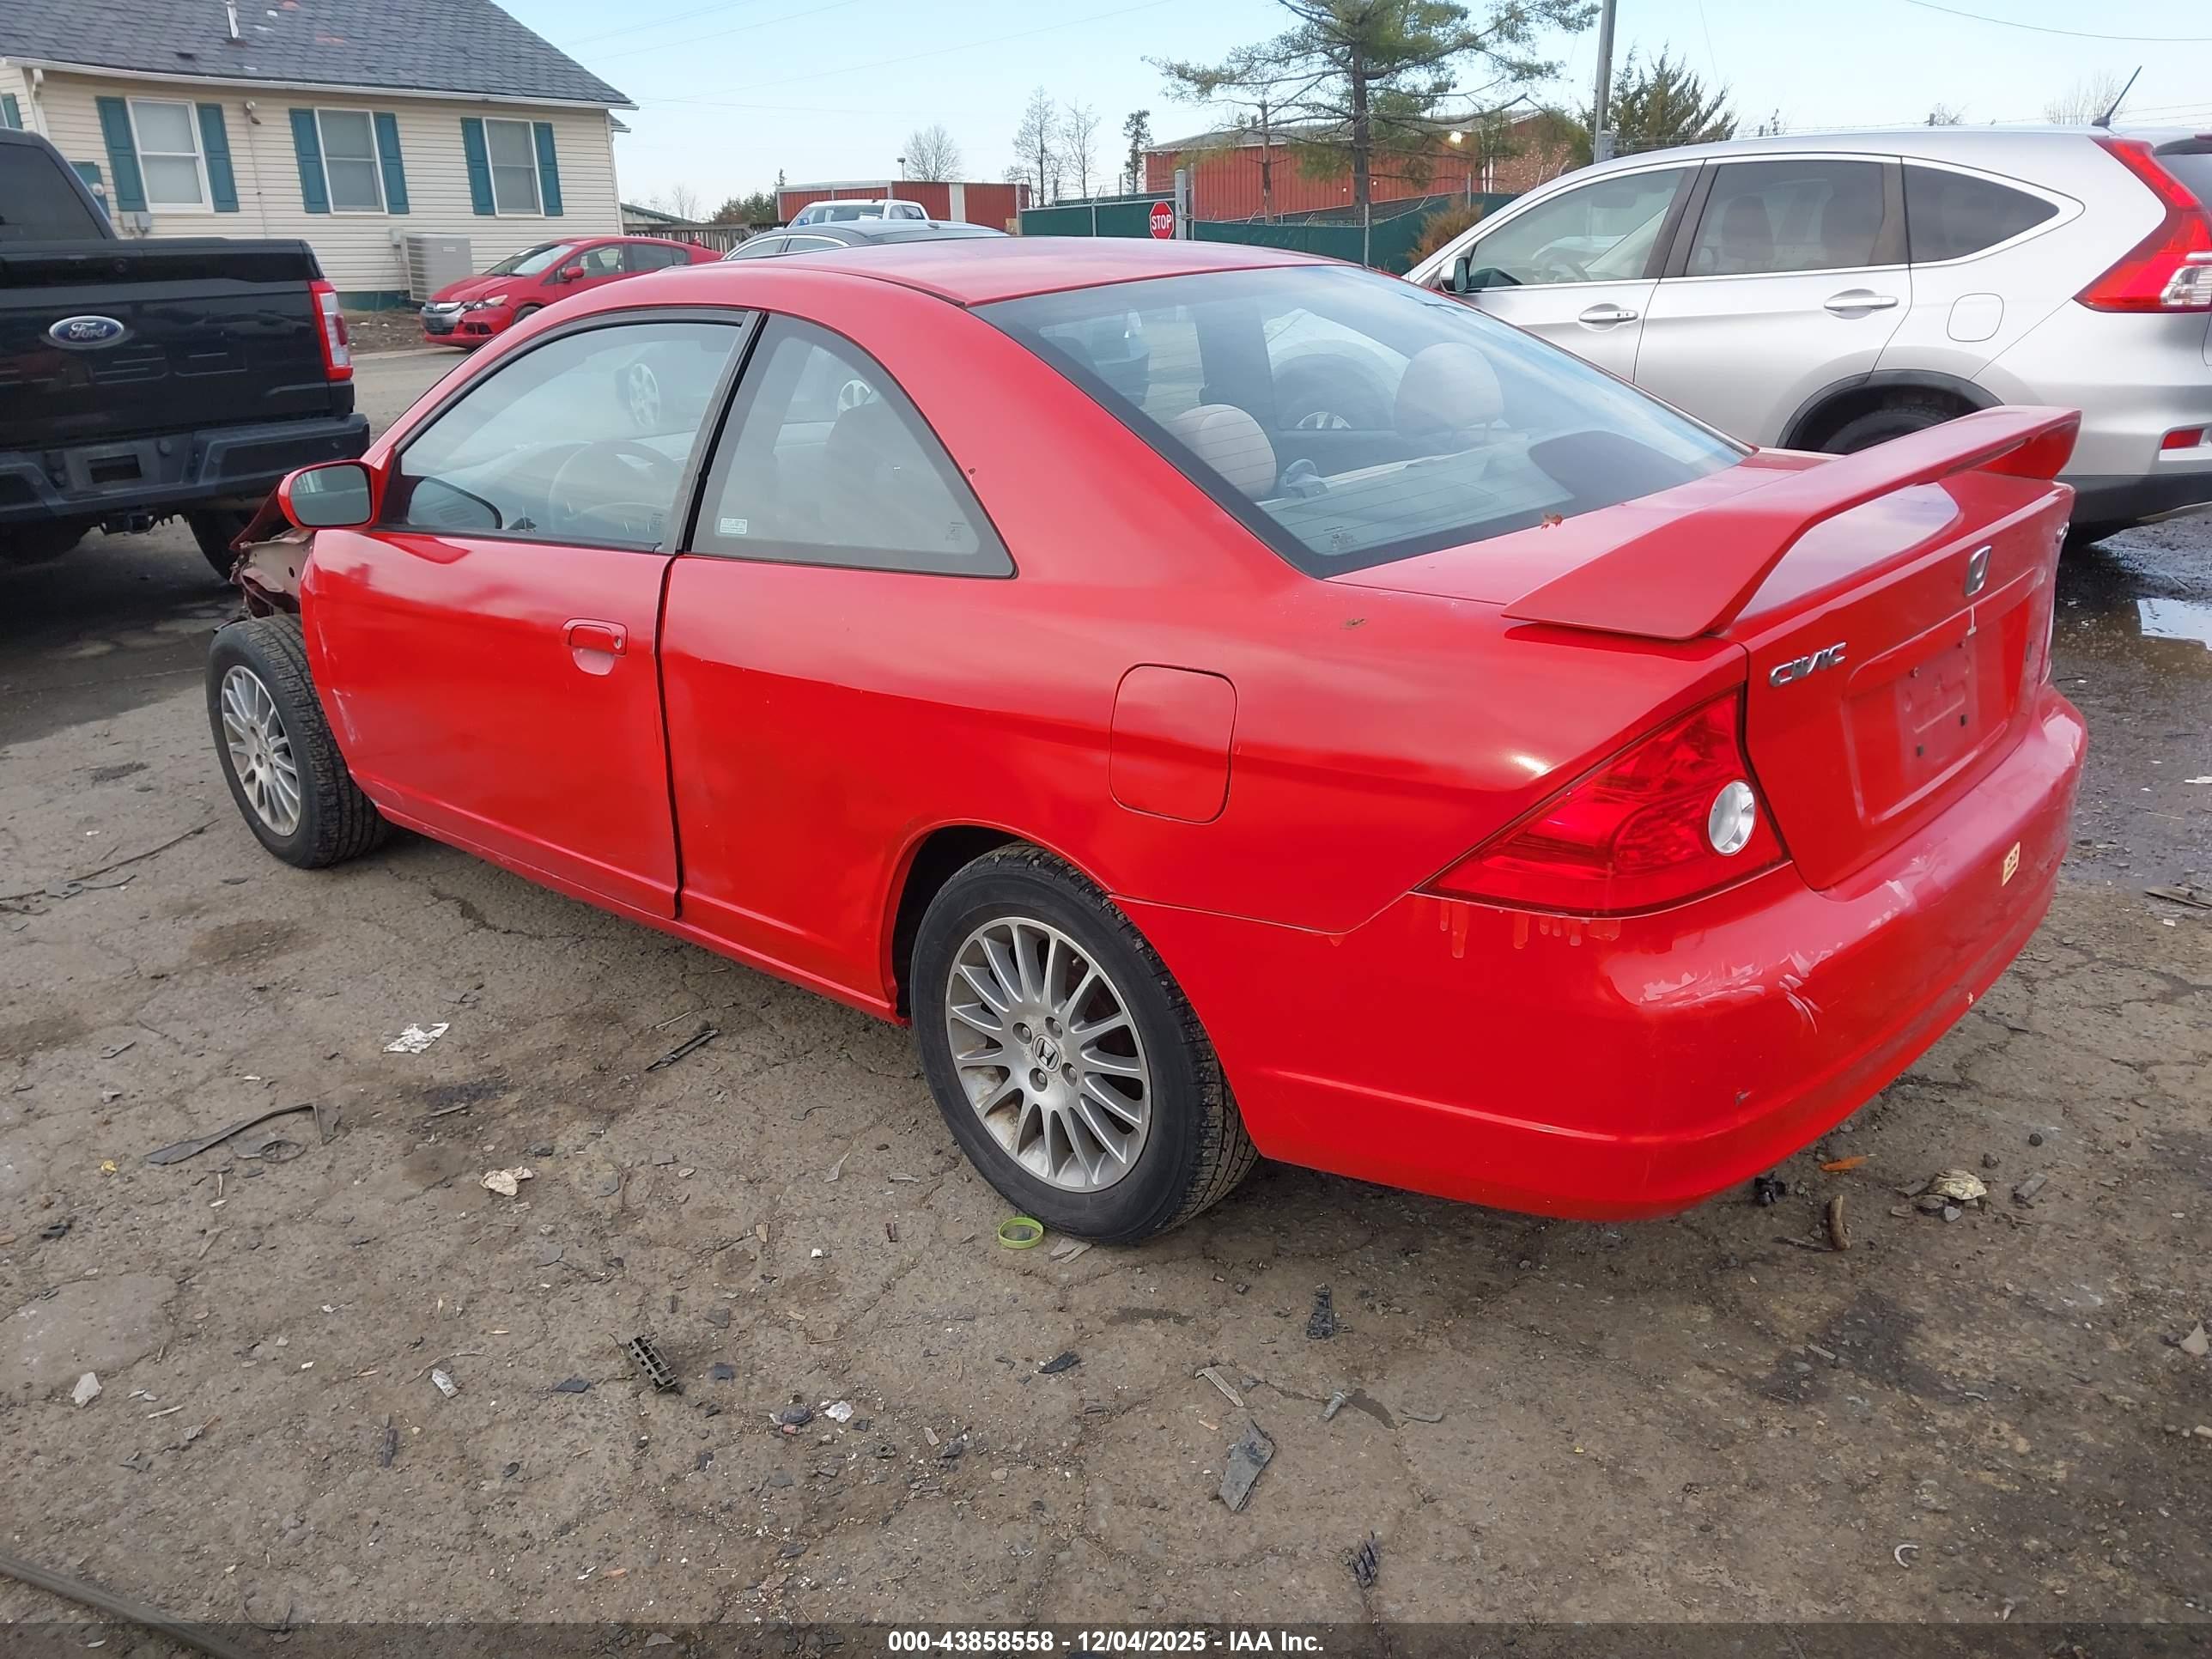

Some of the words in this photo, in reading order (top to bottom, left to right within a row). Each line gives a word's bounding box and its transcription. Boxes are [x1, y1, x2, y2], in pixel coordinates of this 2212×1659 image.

[1152, 214, 1171, 230] STOP
[69, 322, 107, 339] Ford
[1770, 641, 1847, 687] CIVIC
